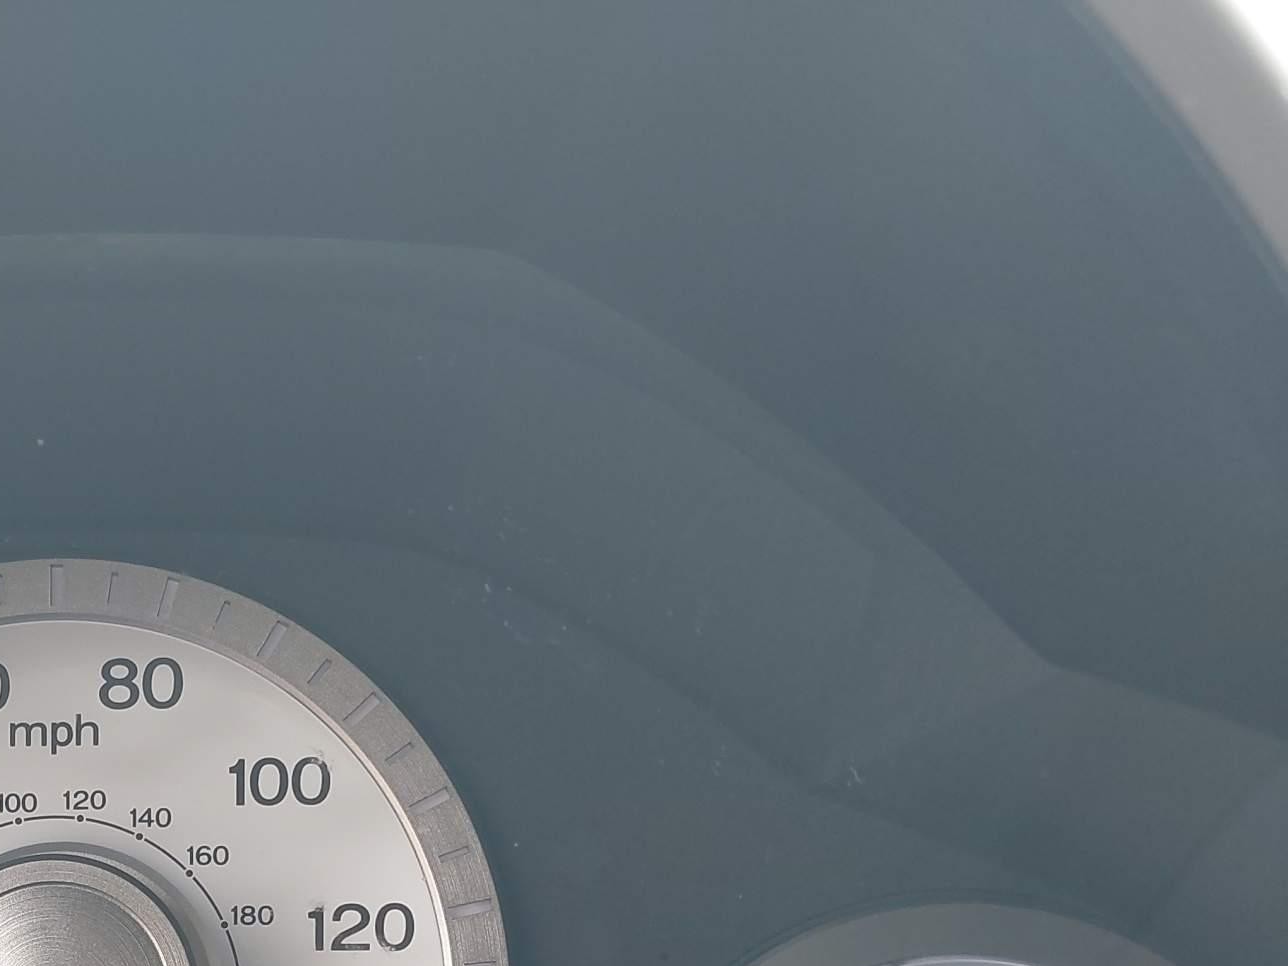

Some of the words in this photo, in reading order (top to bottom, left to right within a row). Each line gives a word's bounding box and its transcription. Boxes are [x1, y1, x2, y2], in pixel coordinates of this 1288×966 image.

[98, 657, 184, 710] 80
[9, 713, 100, 756] mph
[228, 756, 331, 806] 100
[62, 789, 107, 811] 120
[128, 807, 173, 830] 140
[186, 845, 230, 867] 160
[230, 905, 275, 927] 180
[307, 903, 415, 953] 120
